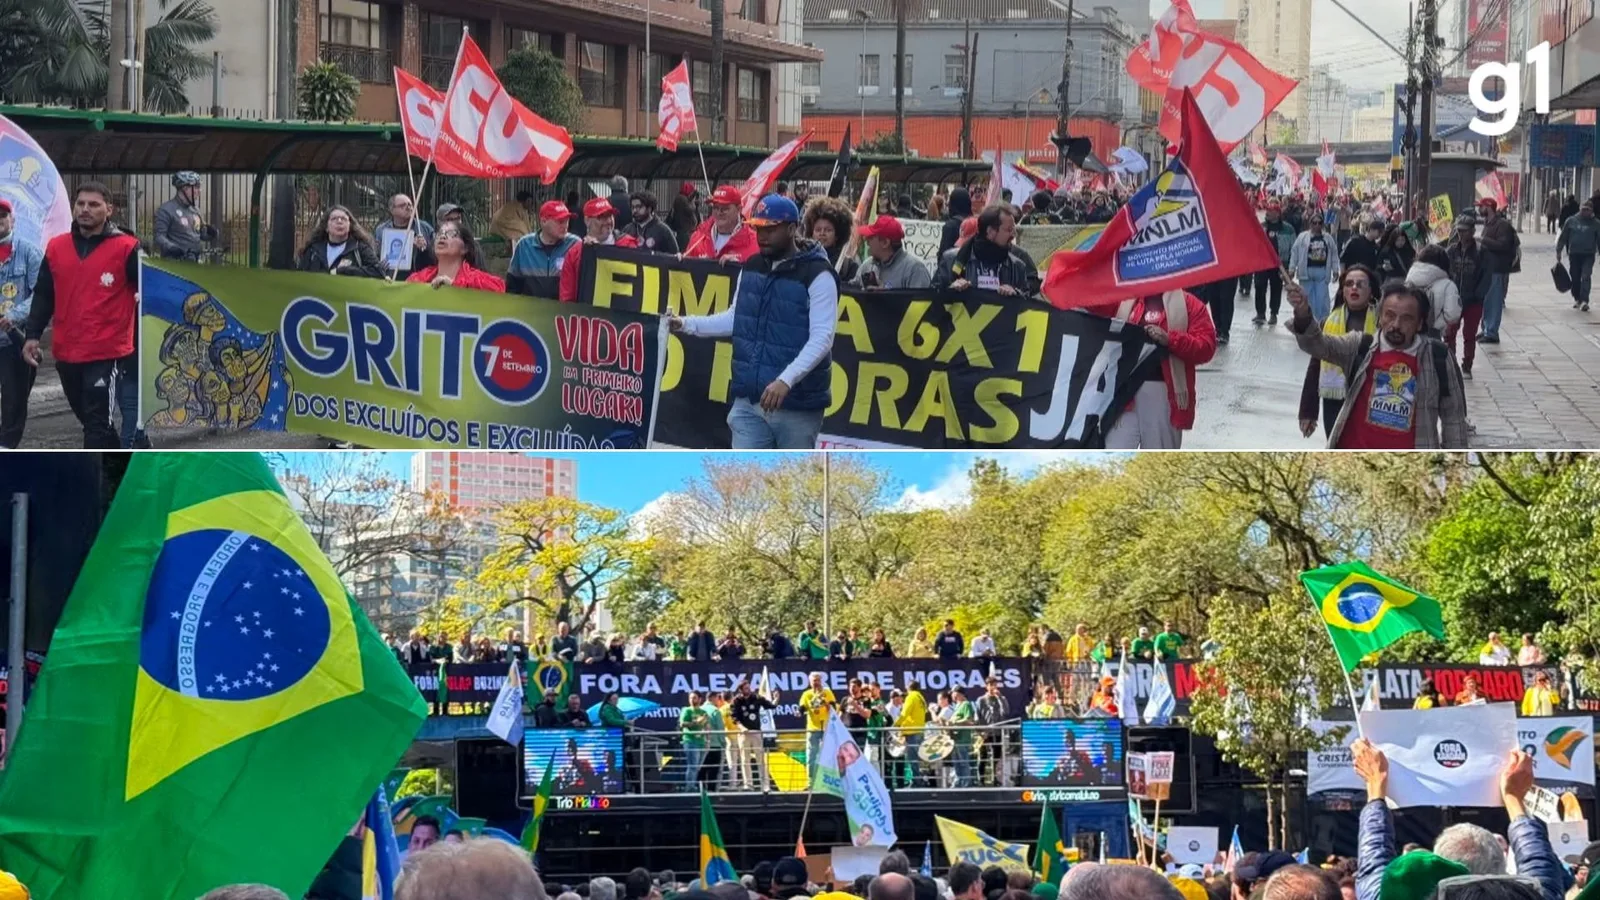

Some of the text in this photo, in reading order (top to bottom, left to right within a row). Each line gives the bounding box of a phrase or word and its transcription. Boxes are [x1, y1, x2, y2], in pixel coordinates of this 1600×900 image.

[593, 257, 731, 318] FIM
[280, 296, 551, 407] GRITO
[480, 344, 500, 378] 7
[502, 349, 514, 359] DE
[554, 315, 645, 375] VIDA
[502, 362, 543, 375] SETEMBRO
[582, 368, 643, 392] PRIMEIRO
[293, 391, 340, 421] DOS
[344, 402, 461, 446] EXCLUÍDOS
[466, 420, 481, 448] E
[561, 383, 643, 427] LUGAR!
[1372, 399, 1410, 416] MNLM
[580, 673, 663, 695] FORA
